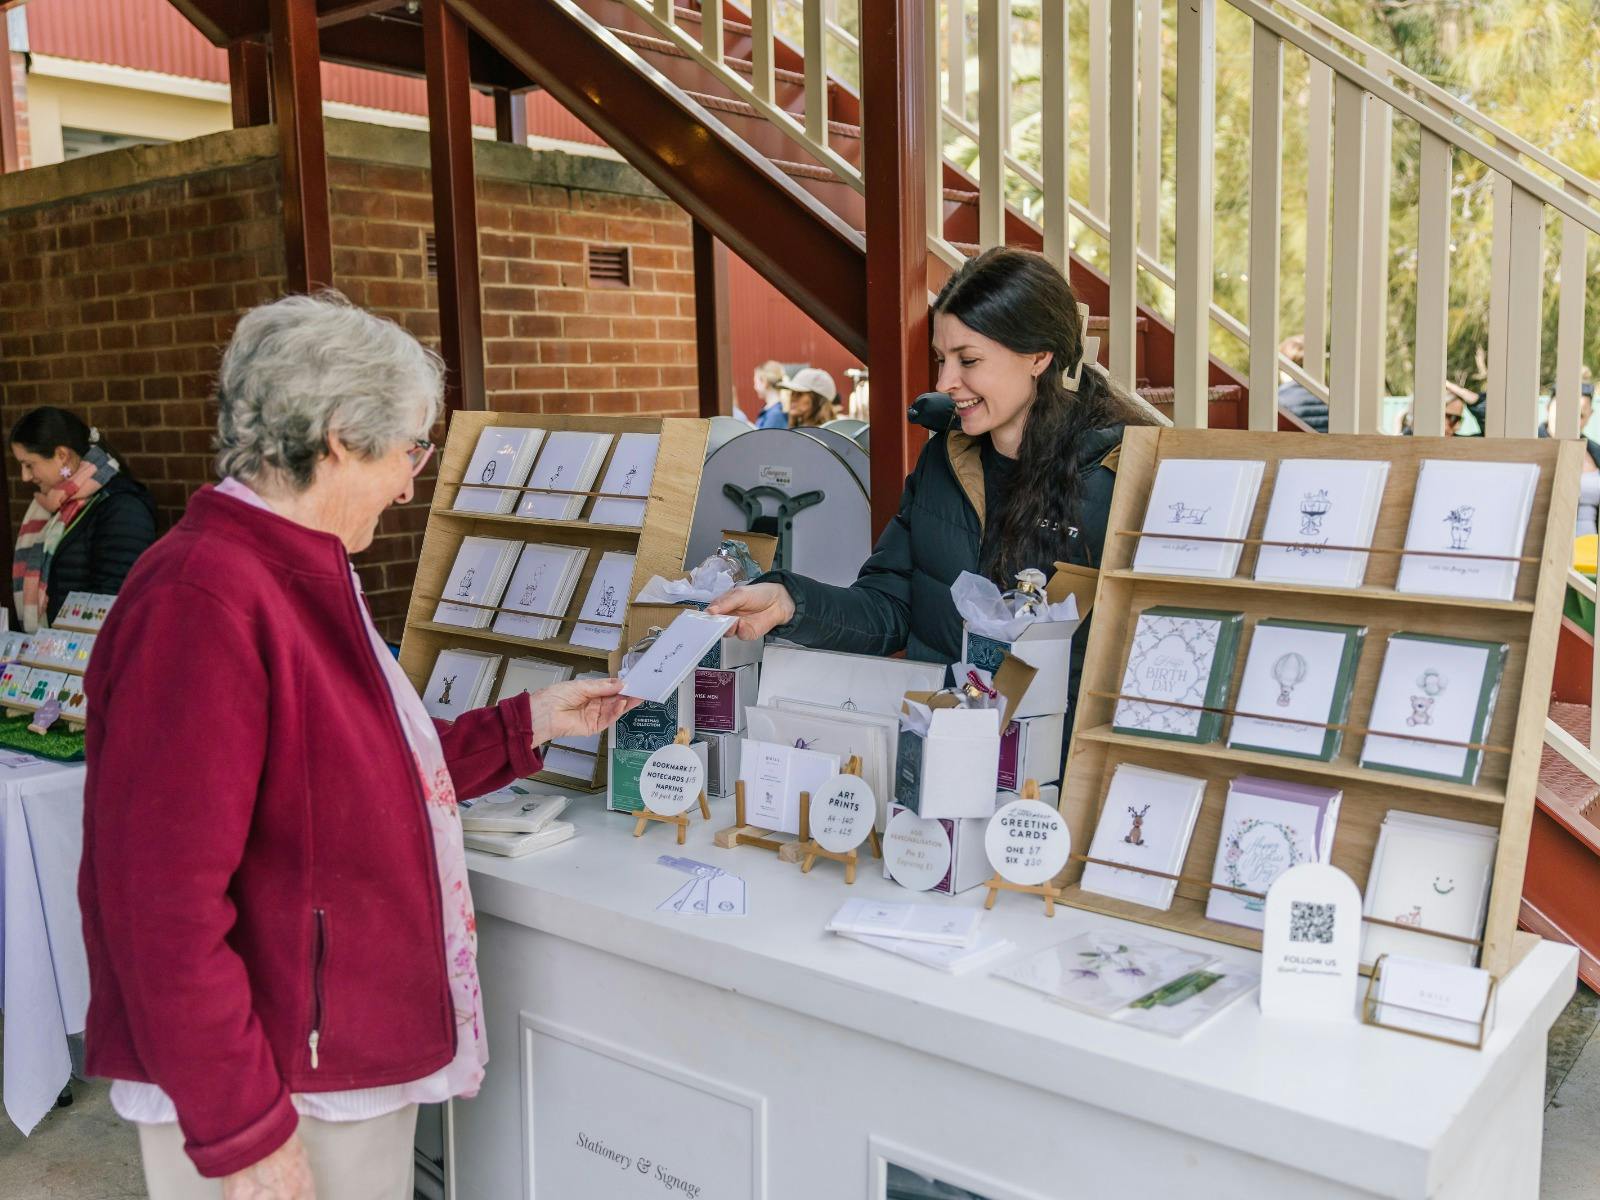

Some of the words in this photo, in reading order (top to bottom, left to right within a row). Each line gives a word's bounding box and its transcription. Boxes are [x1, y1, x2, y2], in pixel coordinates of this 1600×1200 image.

[1146, 666, 1188, 682] BIRTH
[1151, 679, 1176, 693] DAY
[652, 761, 687, 772] BOOKMARK
[647, 772, 684, 783] NOTECARDS
[655, 783, 683, 793] NAPKINS
[838, 790, 855, 800] ART
[828, 798, 860, 812] PRINTS
[1001, 818, 1058, 831] GREETING
[1009, 829, 1048, 841] CARDS
[1006, 846, 1024, 855] ONE
[1029, 846, 1041, 855] $7
[1005, 856, 1018, 864] SIX
[1283, 955, 1323, 965] FOLLOW
[1324, 958, 1337, 967] US
[576, 1132, 632, 1170] Stationery
[636, 1157, 652, 1174] &
[654, 1164, 702, 1200] Signage
